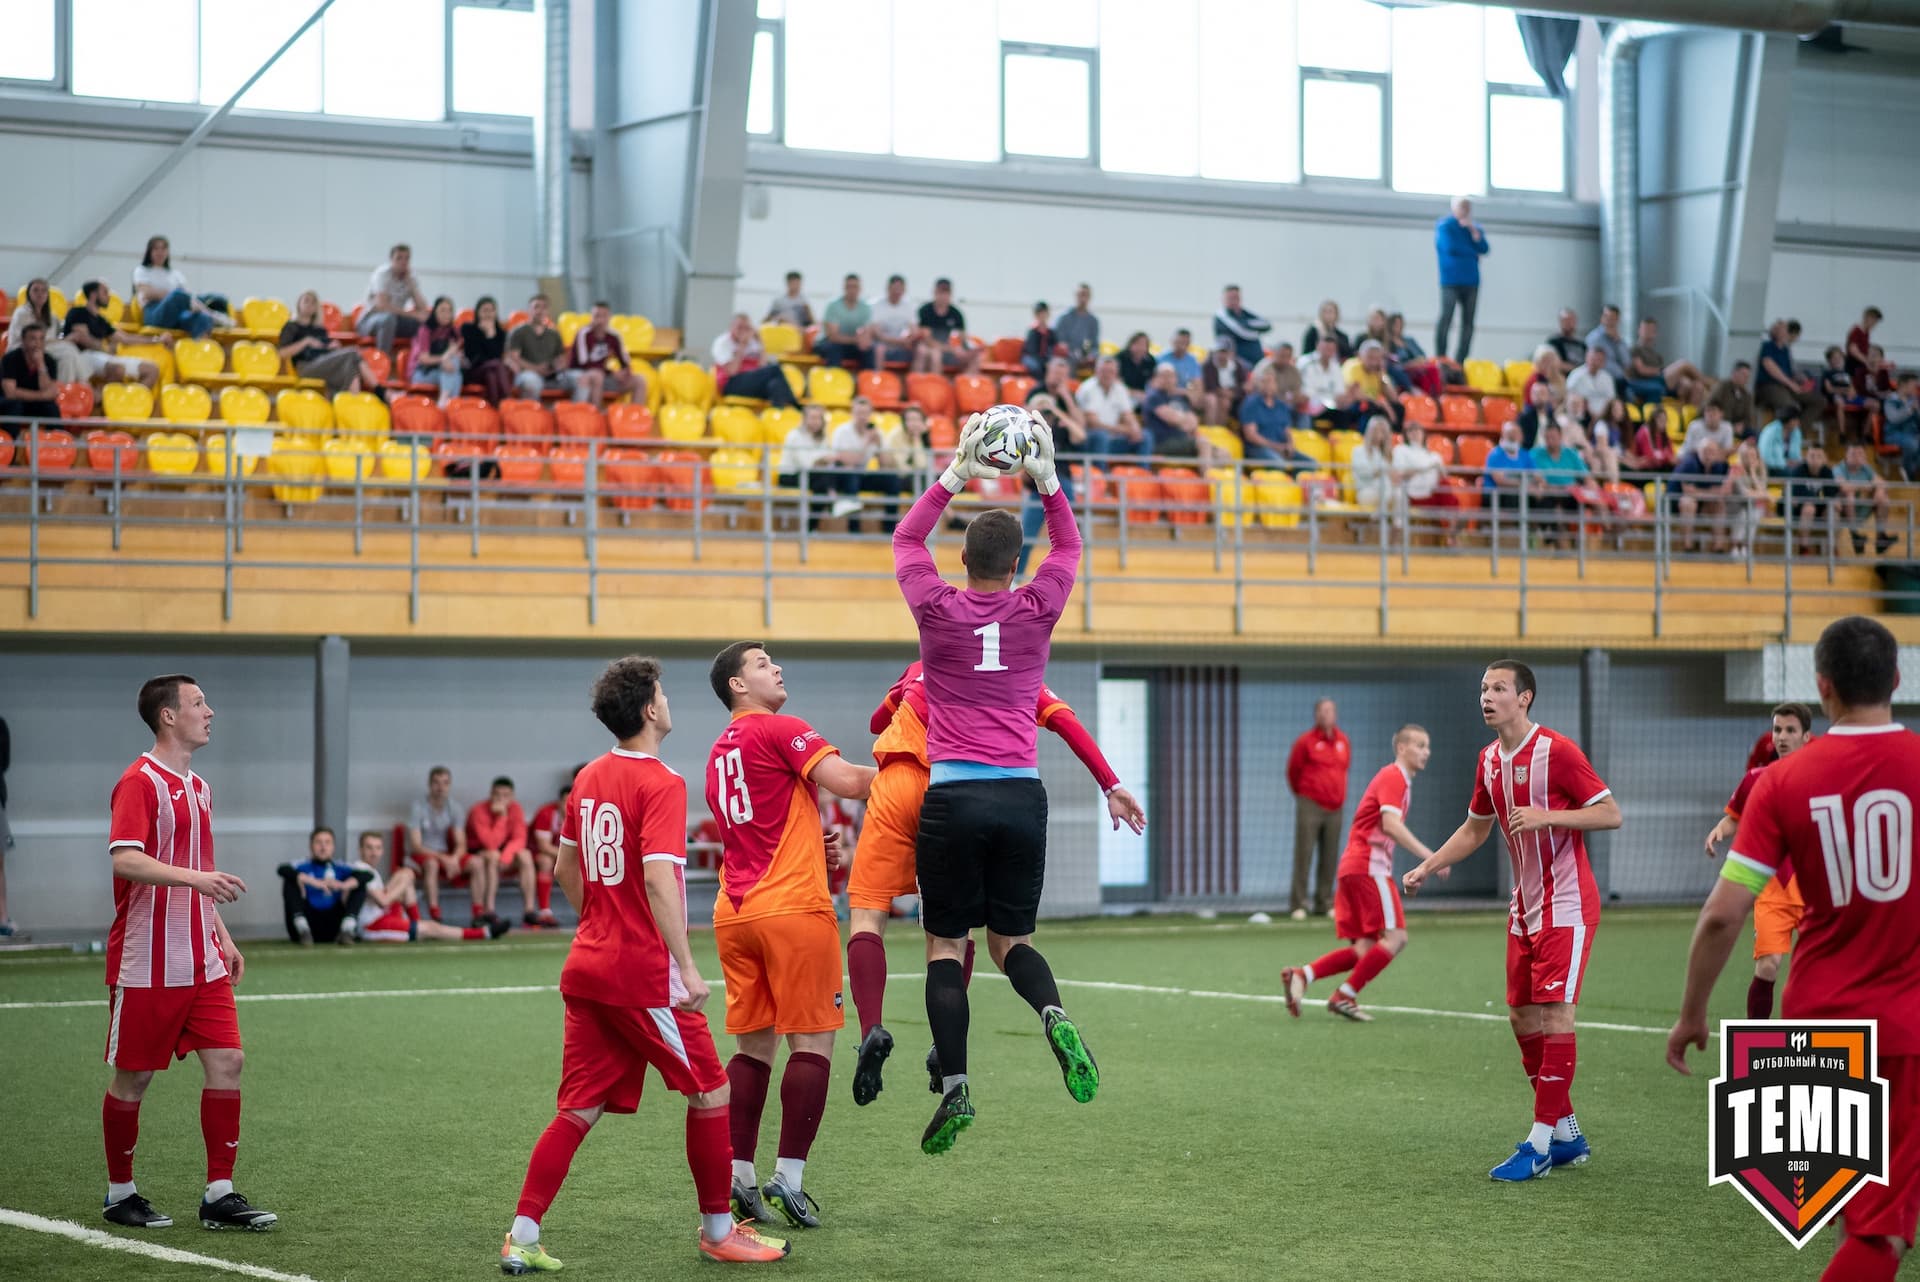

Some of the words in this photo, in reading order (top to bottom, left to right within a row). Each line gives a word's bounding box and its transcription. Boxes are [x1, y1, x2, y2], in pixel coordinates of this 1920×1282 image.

[973, 621, 1009, 671] 1
[715, 748, 754, 829] 13
[580, 798, 625, 886] 18
[1809, 789, 1912, 907] 10
